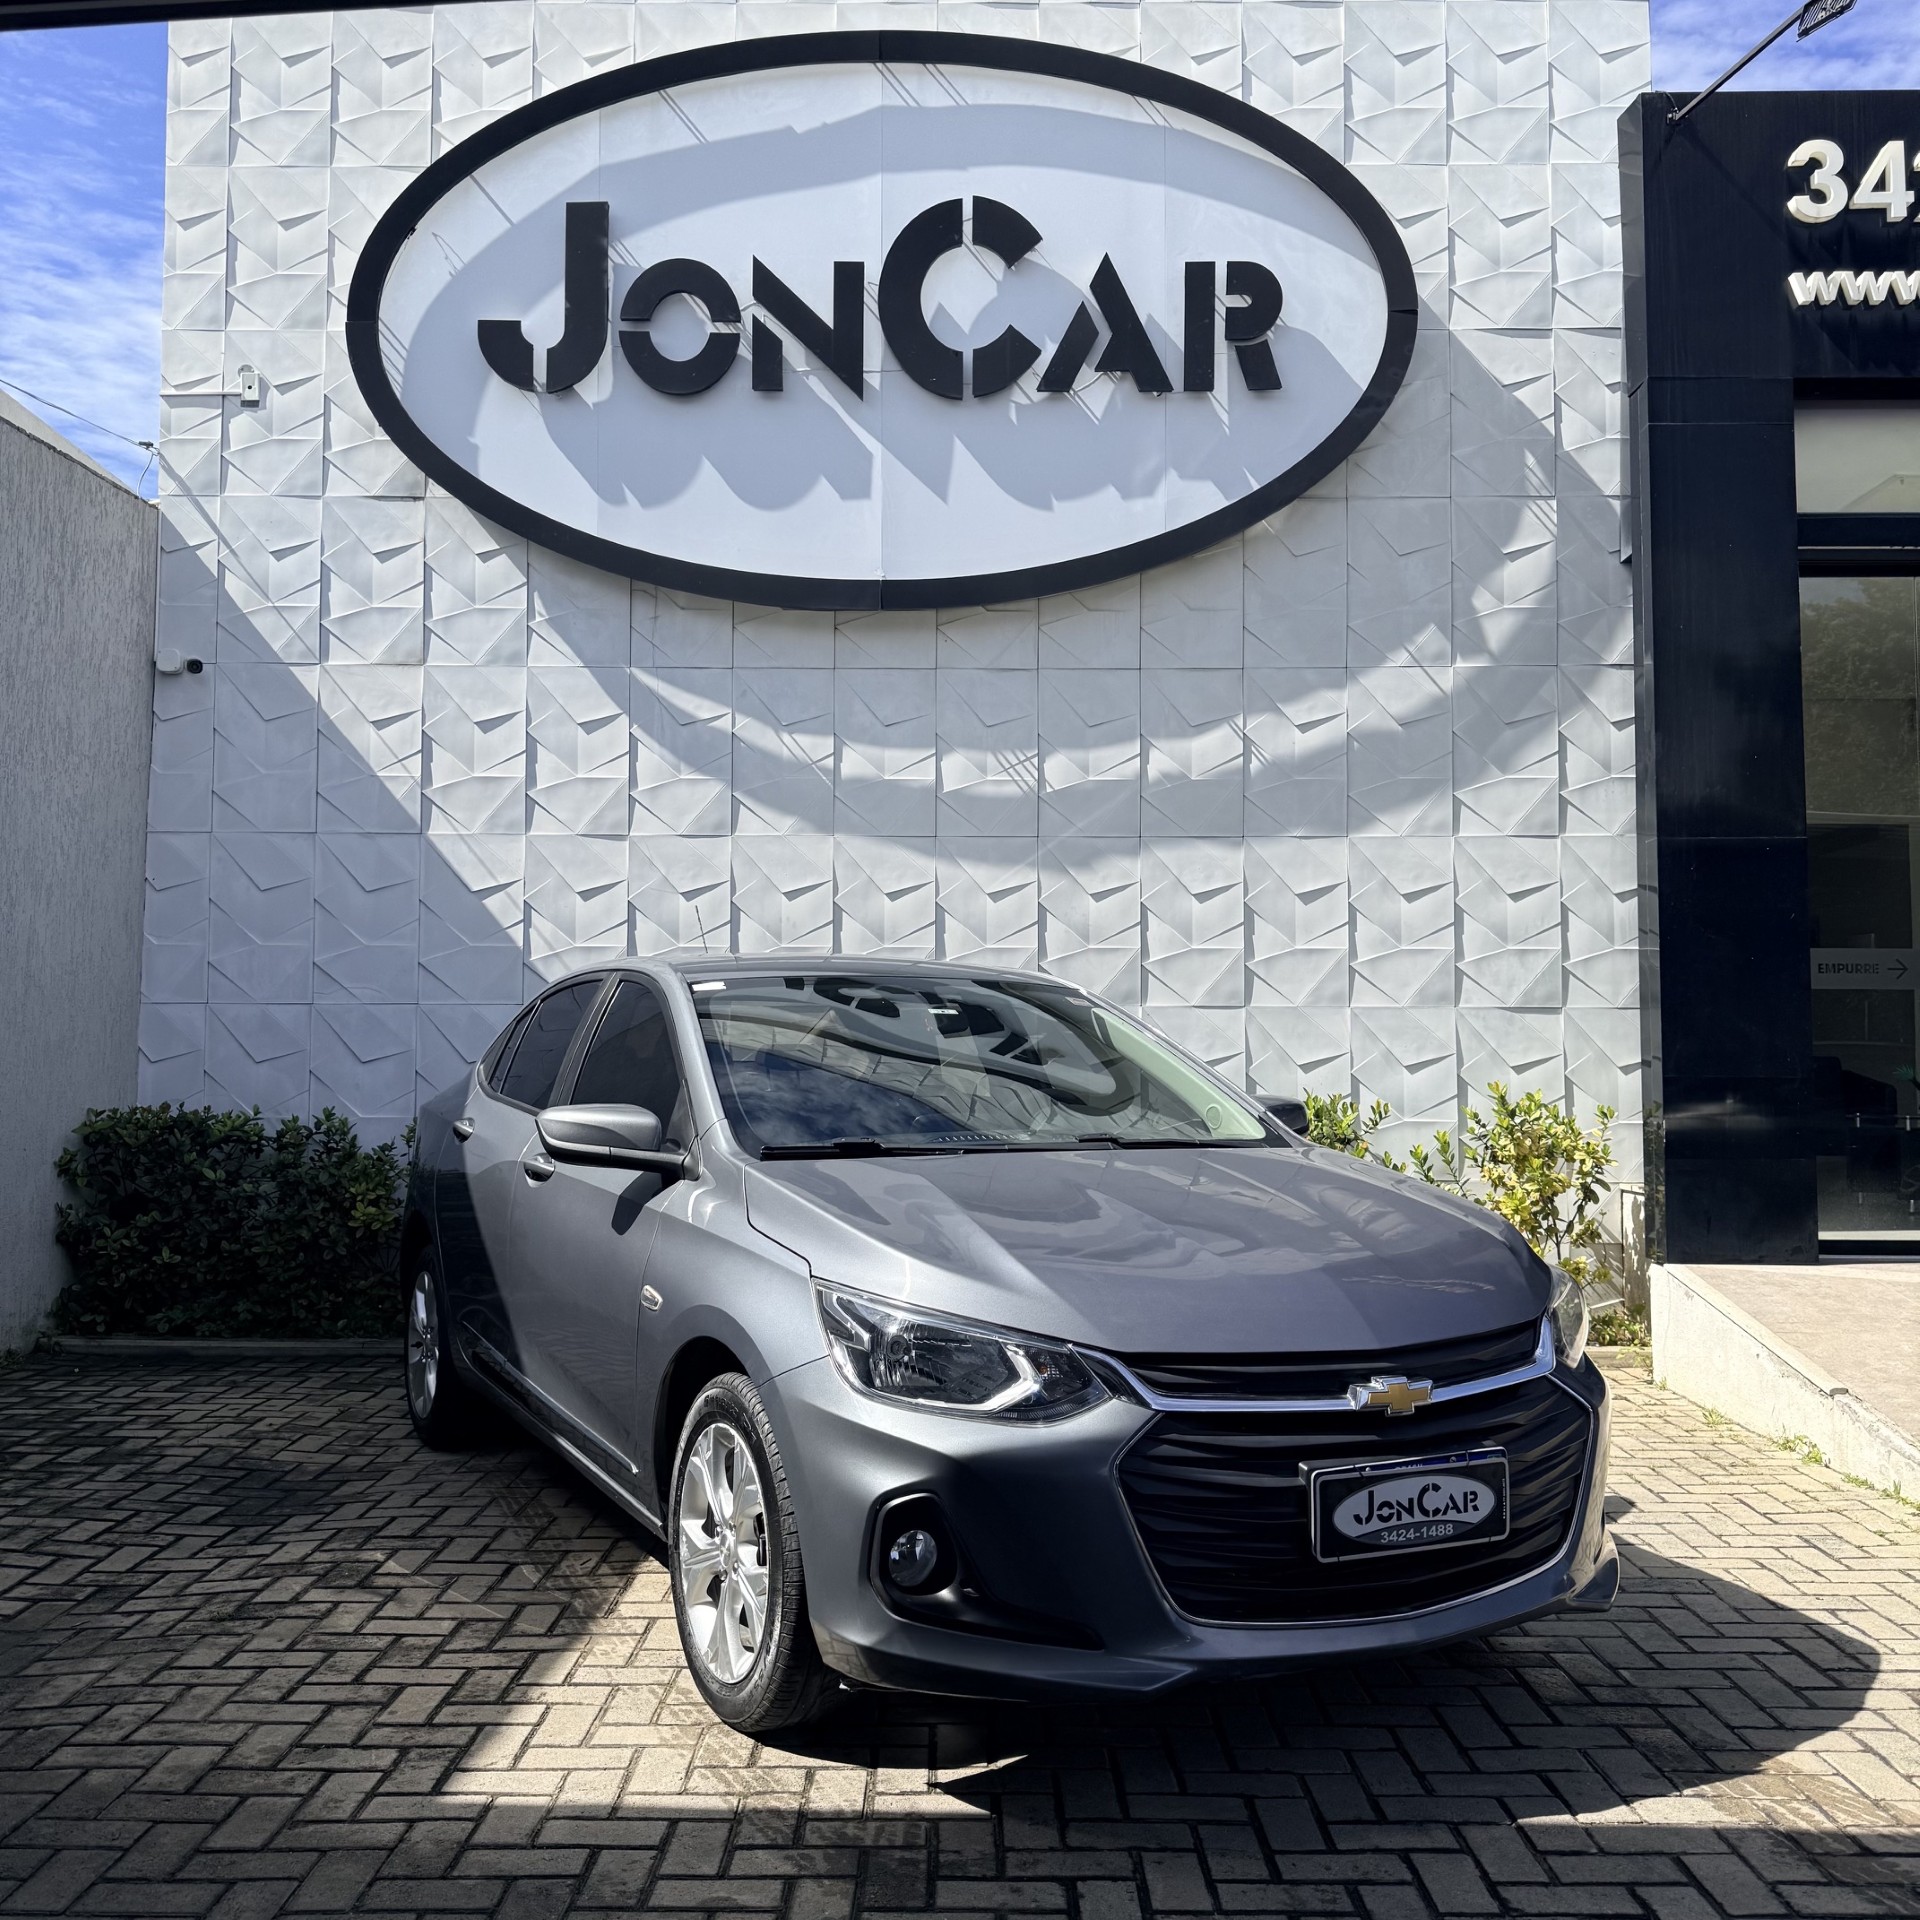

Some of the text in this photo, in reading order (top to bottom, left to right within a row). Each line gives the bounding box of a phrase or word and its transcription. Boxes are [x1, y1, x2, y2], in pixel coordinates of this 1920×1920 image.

[1786, 139, 1920, 224] 34
[1817, 963, 1880, 975] EMPURRE
[1380, 1523, 1454, 1544] 3424-1488
